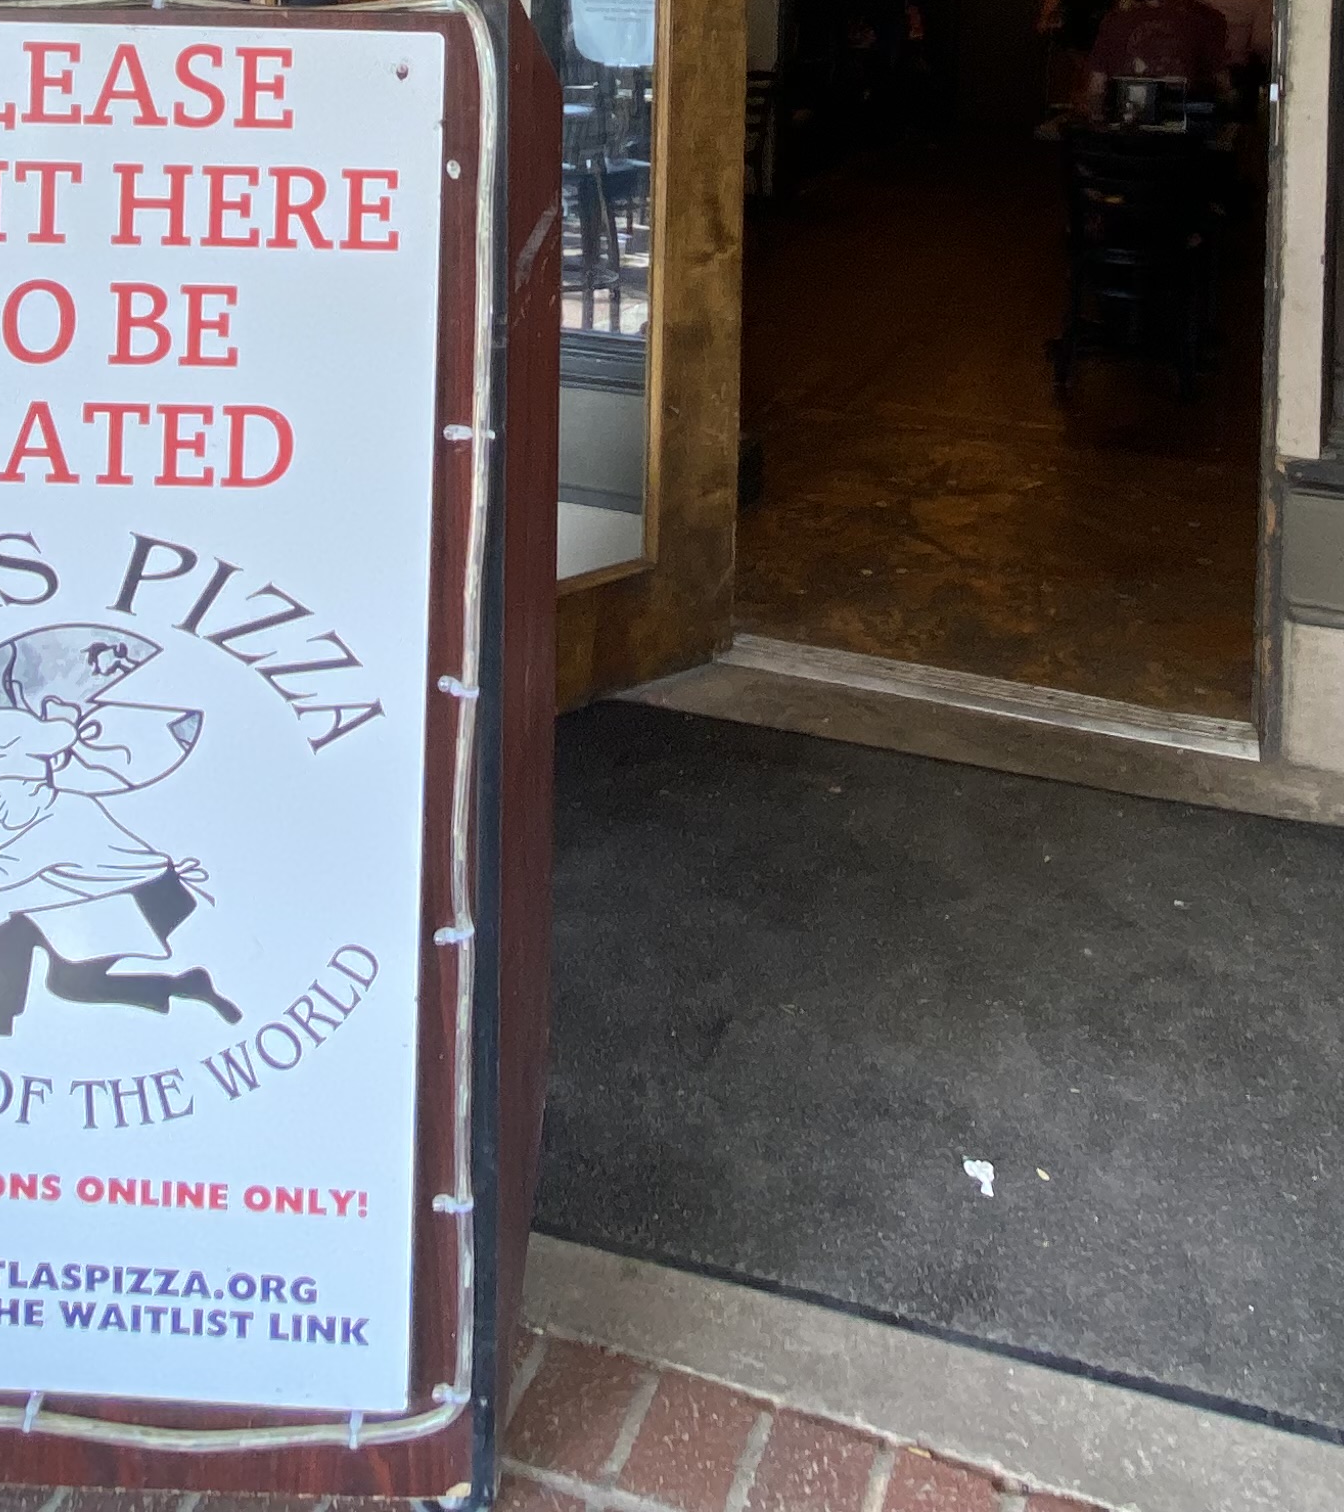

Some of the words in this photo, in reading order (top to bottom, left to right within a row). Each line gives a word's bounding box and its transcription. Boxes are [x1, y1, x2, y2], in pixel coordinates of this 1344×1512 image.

[111, 164, 400, 252] HERE
[108, 282, 240, 368] BE
[106, 531, 386, 755] PIZZA
[69, 1067, 194, 1130] THE
[201, 942, 380, 1102] WORLD
[76, 1176, 229, 1211] ONLINE
[243, 1185, 370, 1219] ONLY!
[57, 1300, 255, 1340] WAITLIST
[269, 1313, 370, 1347] LINK
